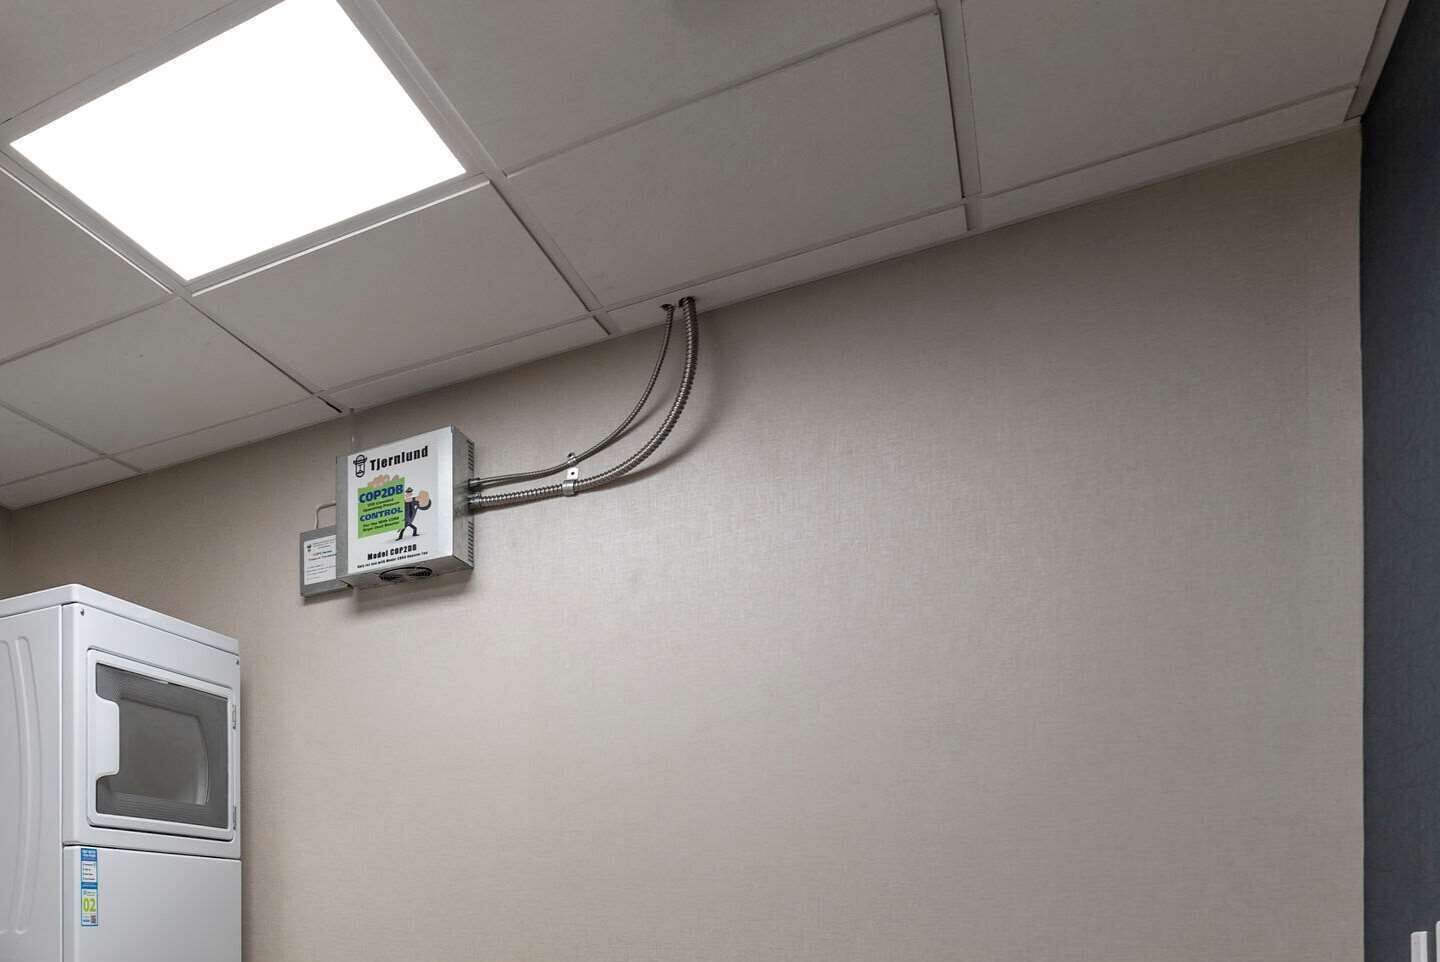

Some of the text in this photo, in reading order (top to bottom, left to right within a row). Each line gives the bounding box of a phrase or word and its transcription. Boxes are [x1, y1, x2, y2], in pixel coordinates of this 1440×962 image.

[370, 445, 428, 471] Tjernlund
[359, 484, 404, 503] COP2DB
[360, 507, 403, 521] CONTROL
[83, 897, 97, 912] 02
